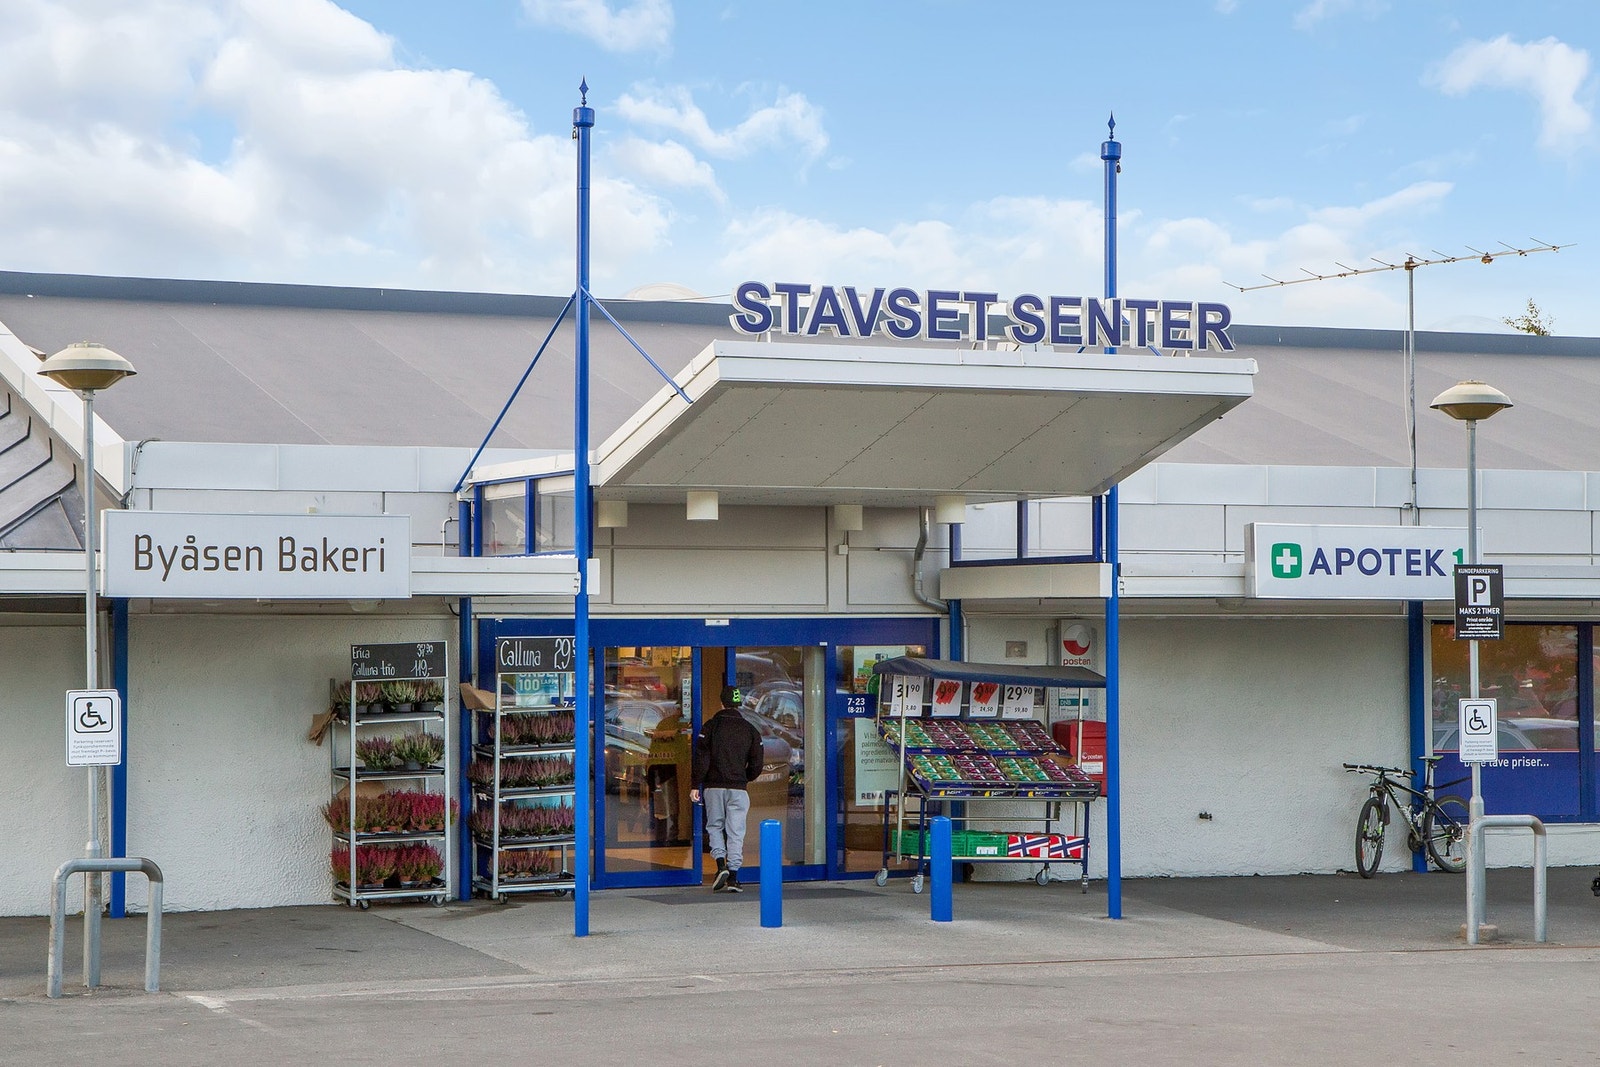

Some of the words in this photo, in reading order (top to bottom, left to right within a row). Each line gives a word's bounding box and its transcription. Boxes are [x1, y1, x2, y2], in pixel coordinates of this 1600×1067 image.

[729, 280, 999, 343] STAVSET
[1006, 294, 1236, 352] SENTER
[133, 533, 263, 582] Byåsen
[277, 535, 386, 573] Bakeri
[1308, 547, 1447, 577] APOTEK
[1472, 578, 1487, 603] P
[1459, 607, 1476, 615] MAKS
[1476, 607, 1481, 615] 2
[1482, 607, 1500, 615] TIMER
[352, 646, 371, 659] Erica
[500, 640, 541, 667] Calluna
[352, 661, 379, 677] Calluna
[380, 660, 396, 676] trio
[1063, 657, 1091, 666] posten
[518, 679, 540, 691] 100
[847, 697, 866, 706] 7-23
[1511, 756, 1549, 770] priser...
